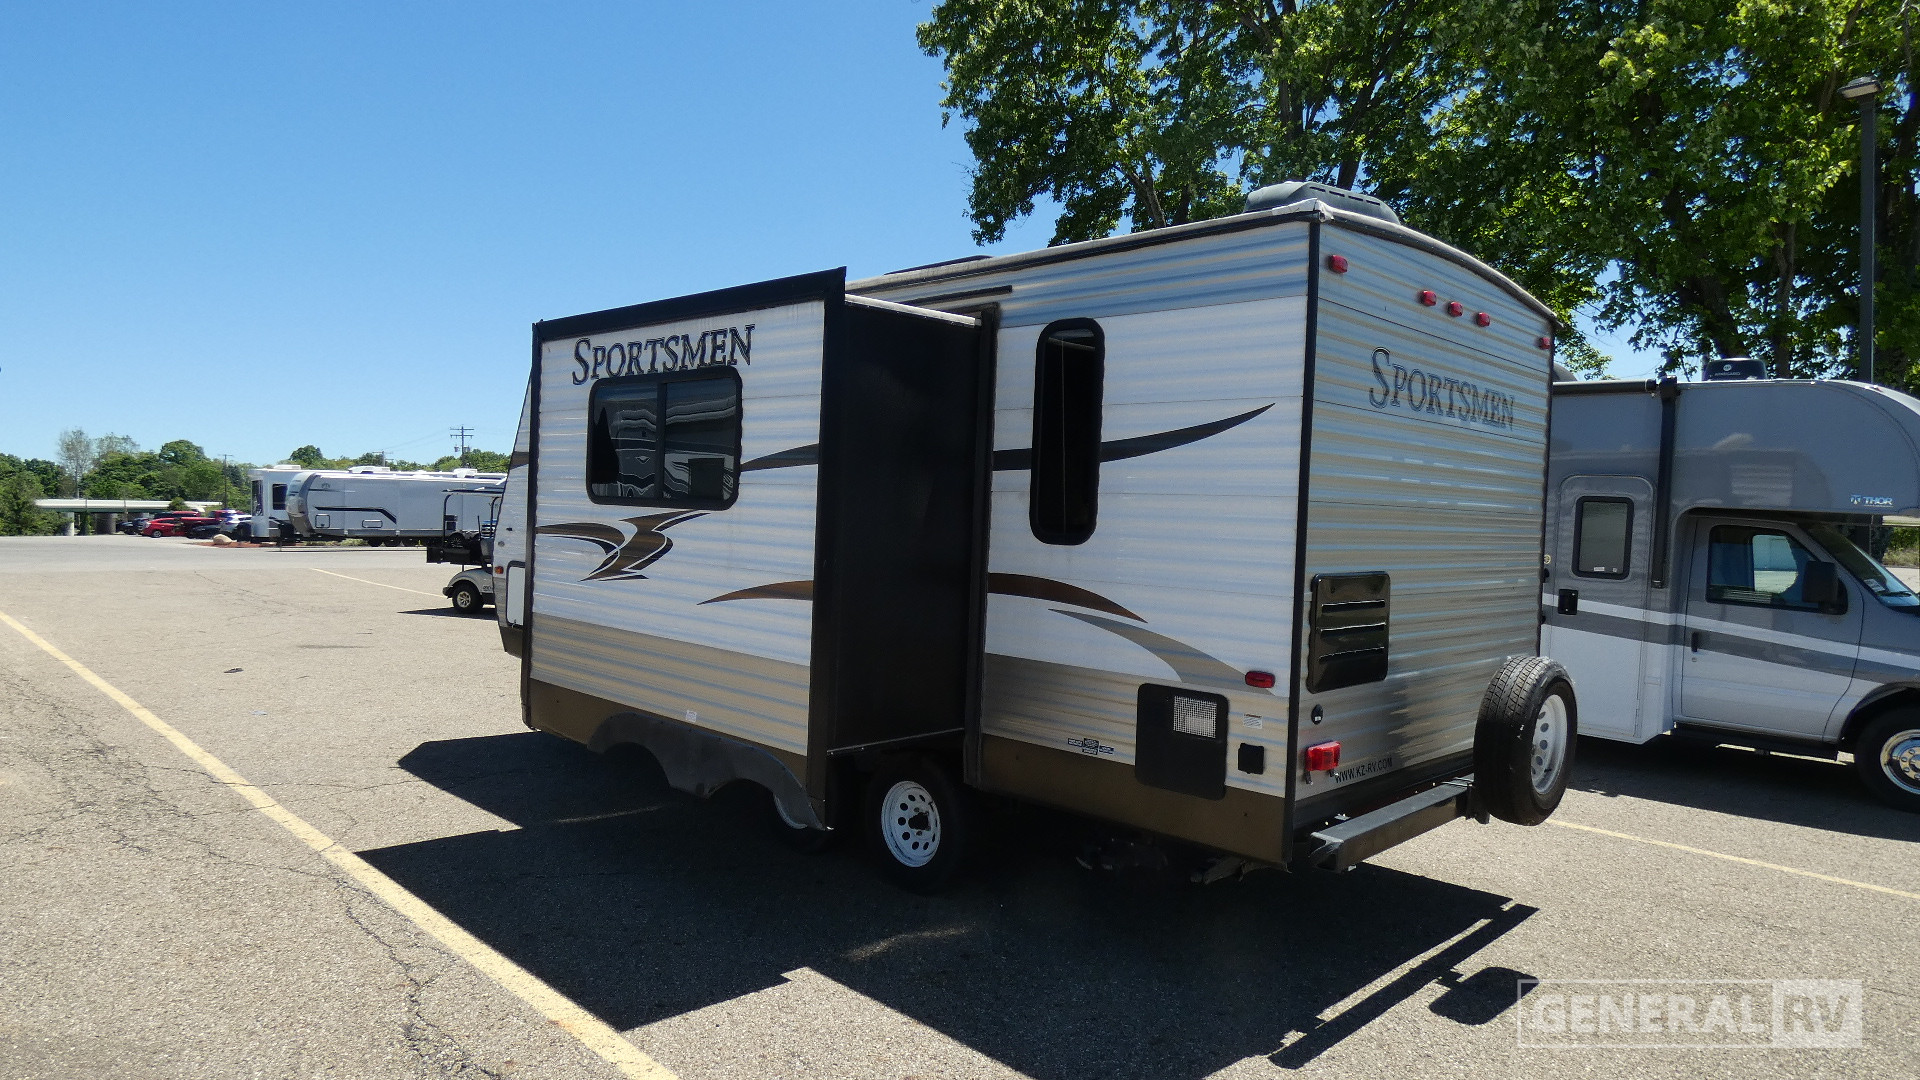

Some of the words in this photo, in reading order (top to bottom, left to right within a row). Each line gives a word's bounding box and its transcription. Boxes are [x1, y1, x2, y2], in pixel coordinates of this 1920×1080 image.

[572, 323, 756, 386] SPORTSMEN
[1368, 346, 1516, 431] SPORTSMEN
[1862, 496, 1893, 506] THOR
[1334, 757, 1393, 784] WWW.KZ-RV.COM
